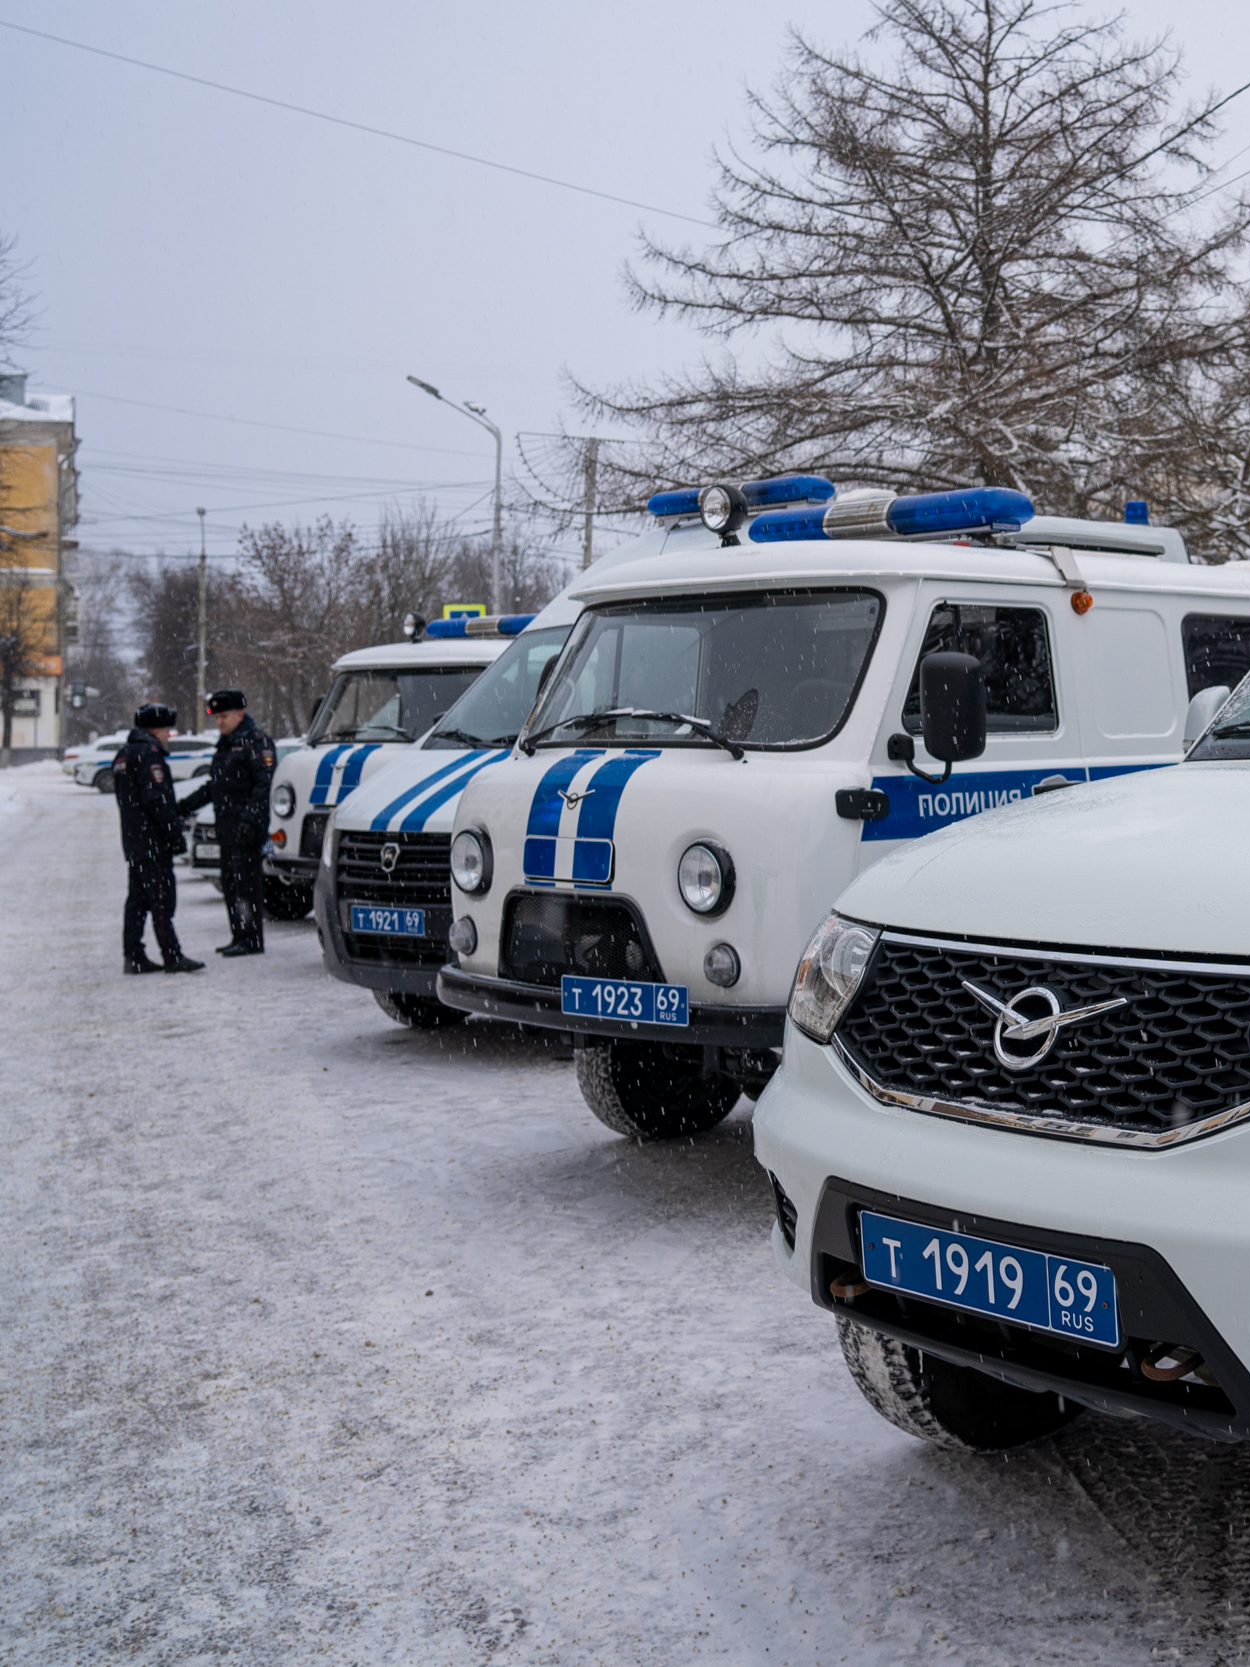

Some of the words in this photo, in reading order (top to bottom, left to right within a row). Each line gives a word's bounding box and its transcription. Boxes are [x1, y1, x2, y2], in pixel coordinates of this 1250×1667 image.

[369, 910, 399, 931] 1921
[406, 910, 420, 927] 69
[592, 984, 643, 1016] 1923
[656, 988, 680, 1011] 69
[660, 1011, 677, 1021] RUS
[922, 1237, 1024, 1310] 1919
[1054, 1264, 1098, 1313] 69
[1061, 1310, 1094, 1333] RUS
